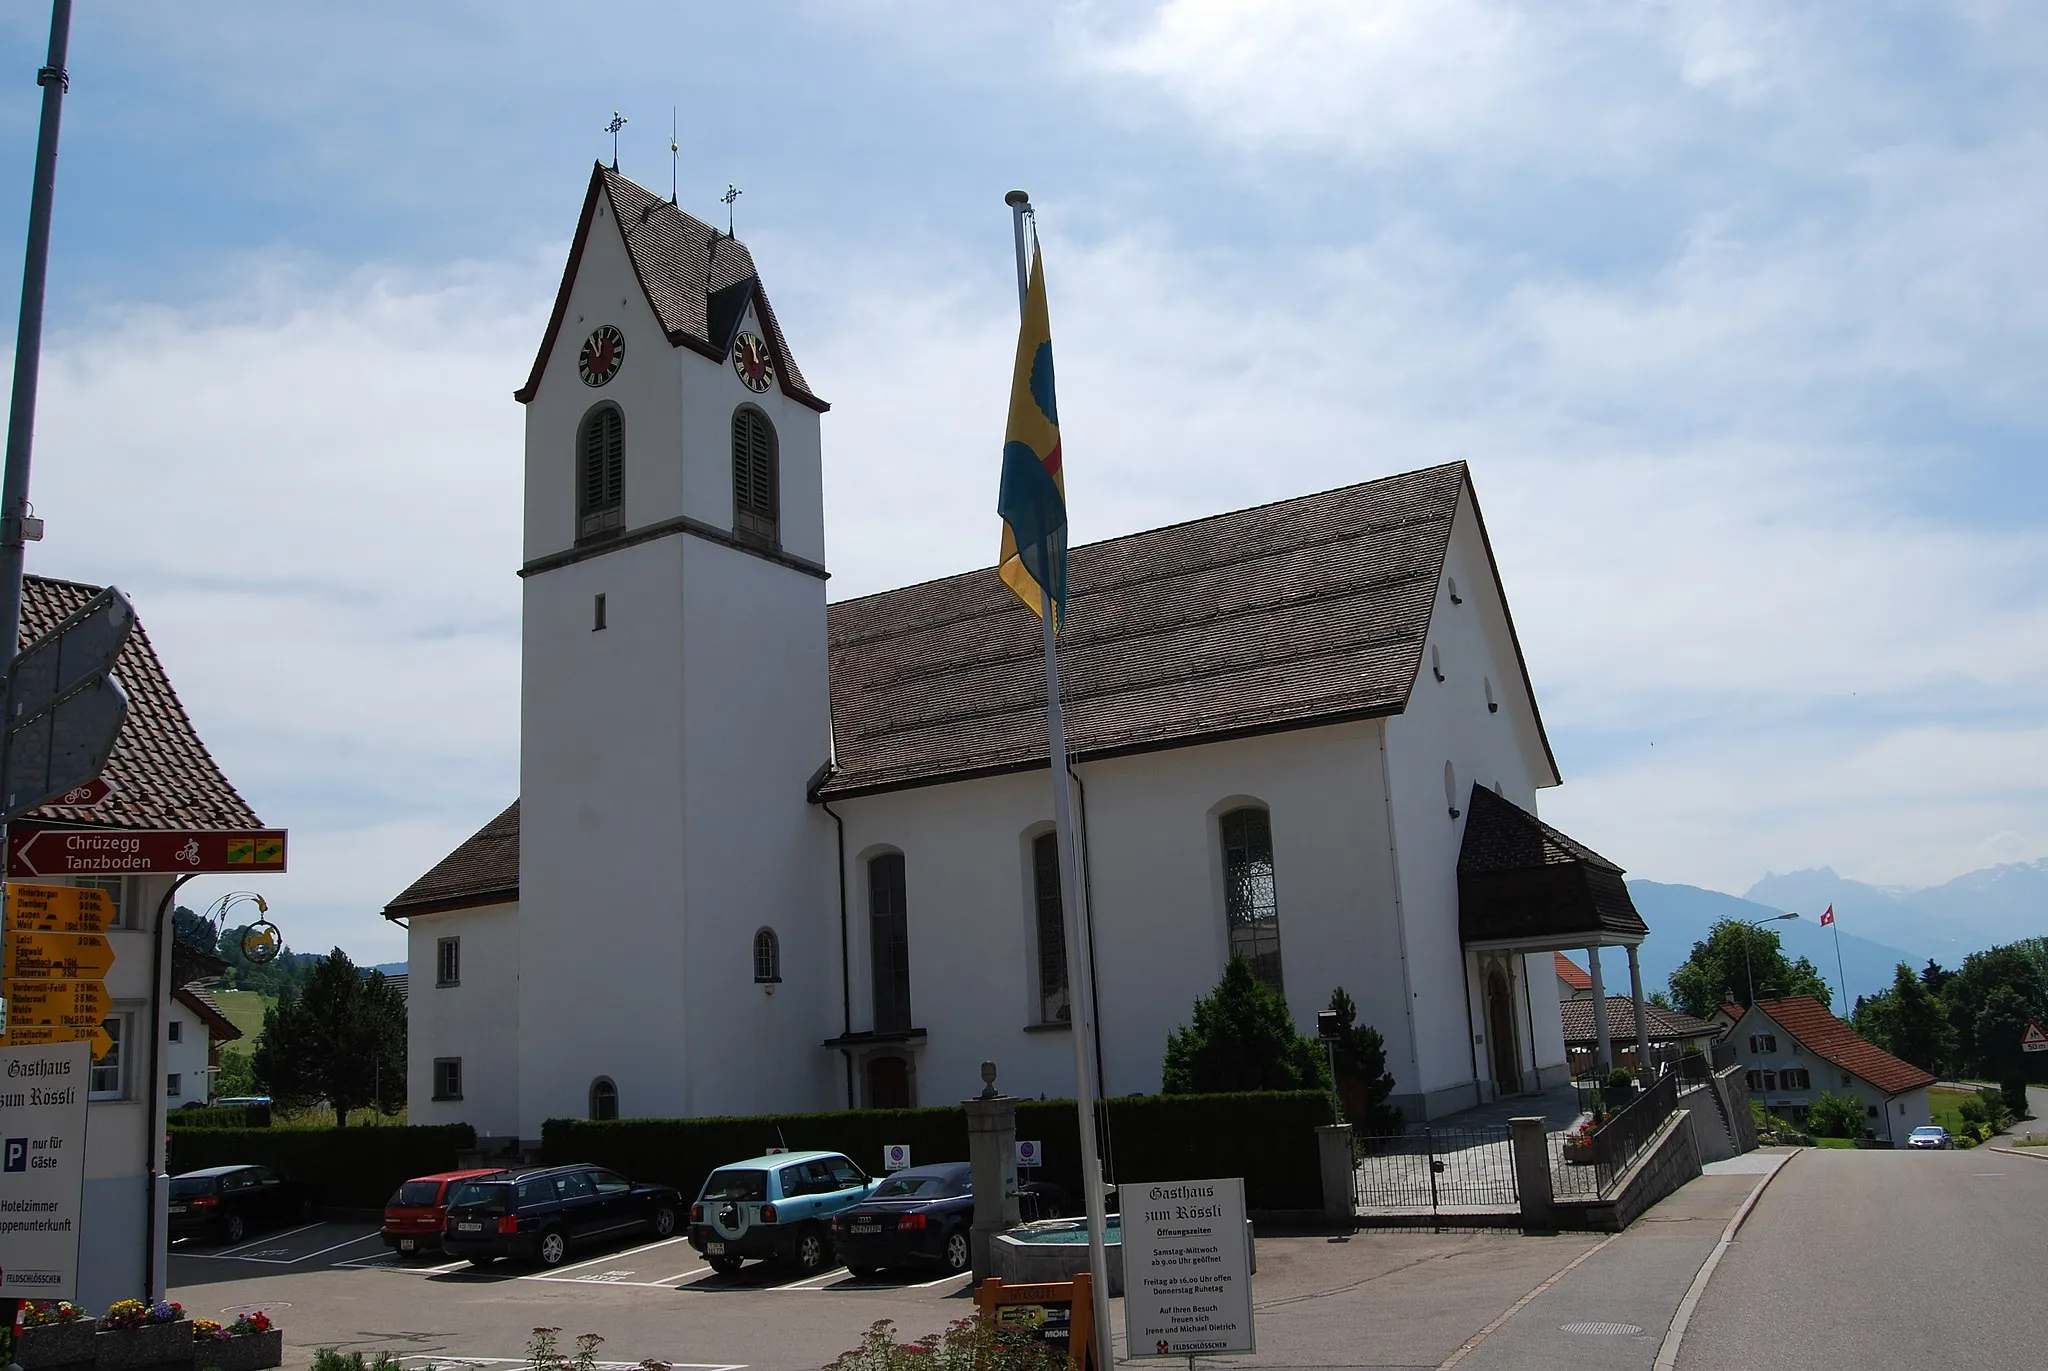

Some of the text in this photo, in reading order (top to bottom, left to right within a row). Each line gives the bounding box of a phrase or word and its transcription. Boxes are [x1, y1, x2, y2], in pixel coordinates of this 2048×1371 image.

[66, 836, 140, 852] Chrüzegg
[66, 854, 151, 869] Tanzboden
[18, 888, 58, 900] Hinterbergen
[17, 910, 40, 920] Laupen
[17, 920, 33, 929] Wald
[16, 946, 43, 957] Eggwald
[74, 1005, 85, 1013] 50
[11, 1015, 33, 1025] Ricken
[74, 1030, 85, 1038] 20
[86, 1030, 99, 1039] Min.
[7, 1059, 71, 1080] Gasthaus
[0, 1086, 76, 1112] zum Rössli
[8, 1137, 63, 1167] P nur für
[31, 1156, 58, 1169] Gäste
[1149, 1185, 1214, 1200] Gasthaus
[1, 1200, 58, 1212] Hotelzimmer
[1145, 1205, 1222, 1223] zum Rössli
[1157, 1227, 1212, 1237] Öffnungszeiten
[1153, 1246, 1218, 1256] Samstag-Mittwoch
[1151, 1258, 1160, 1266] ab
[1179, 1257, 1191, 1265] Uhr
[1192, 1256, 1221, 1265] geöffnet
[6, 1273, 61, 1284] FELDSCHLÖSSCHEN
[1144, 1279, 1167, 1287] Freitag
[1153, 1285, 1223, 1295] Donnerstag Ruhetag
[1165, 1326, 1178, 1334] und
[1180, 1325, 1207, 1333] Michael
[1209, 1323, 1236, 1331] Dietrich
[1173, 1341, 1227, 1350] FELDSCHLÖSSCHEN
